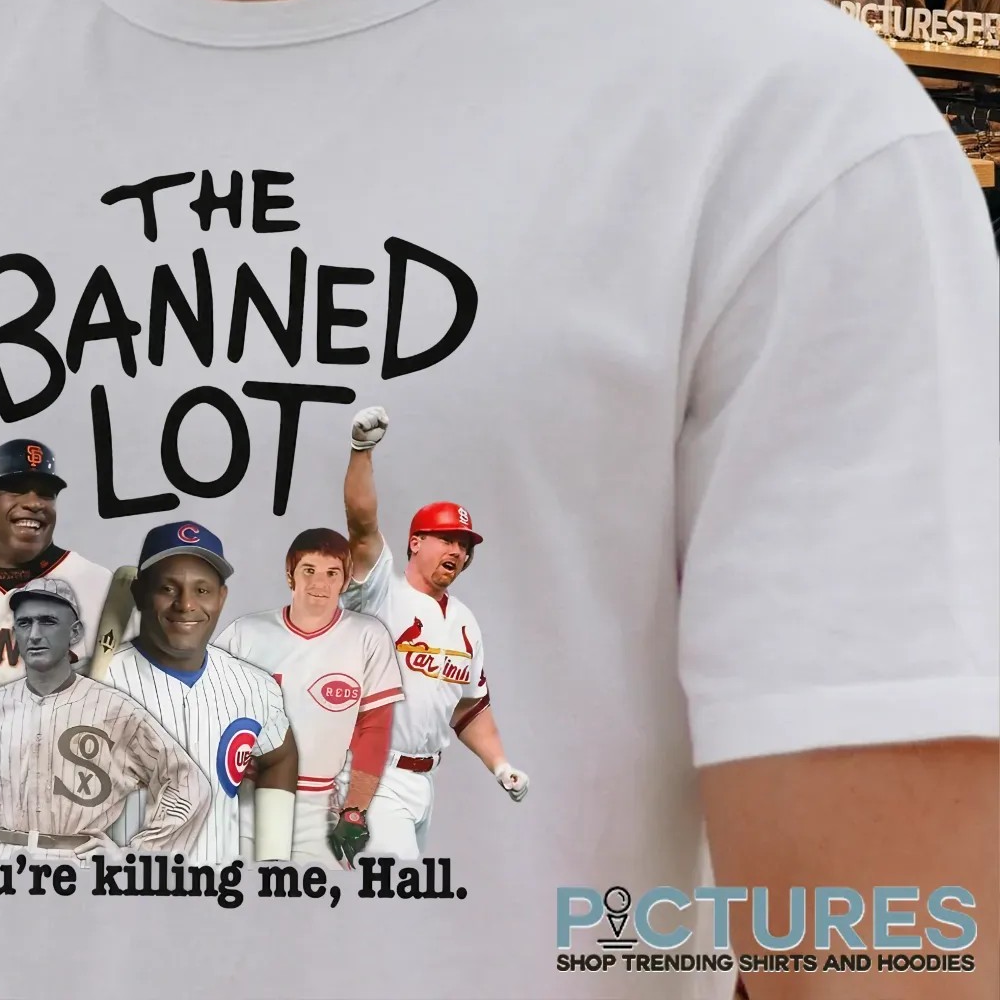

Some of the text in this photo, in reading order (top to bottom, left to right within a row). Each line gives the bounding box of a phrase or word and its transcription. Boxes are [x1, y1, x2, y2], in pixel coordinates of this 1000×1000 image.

[100, 169, 300, 242] THE
[90, 380, 356, 519] LOT
[325, 687, 359, 699] REDS
[91, 853, 243, 909] killing
[257, 863, 342, 908] me,
[357, 857, 468, 900] Hall.
